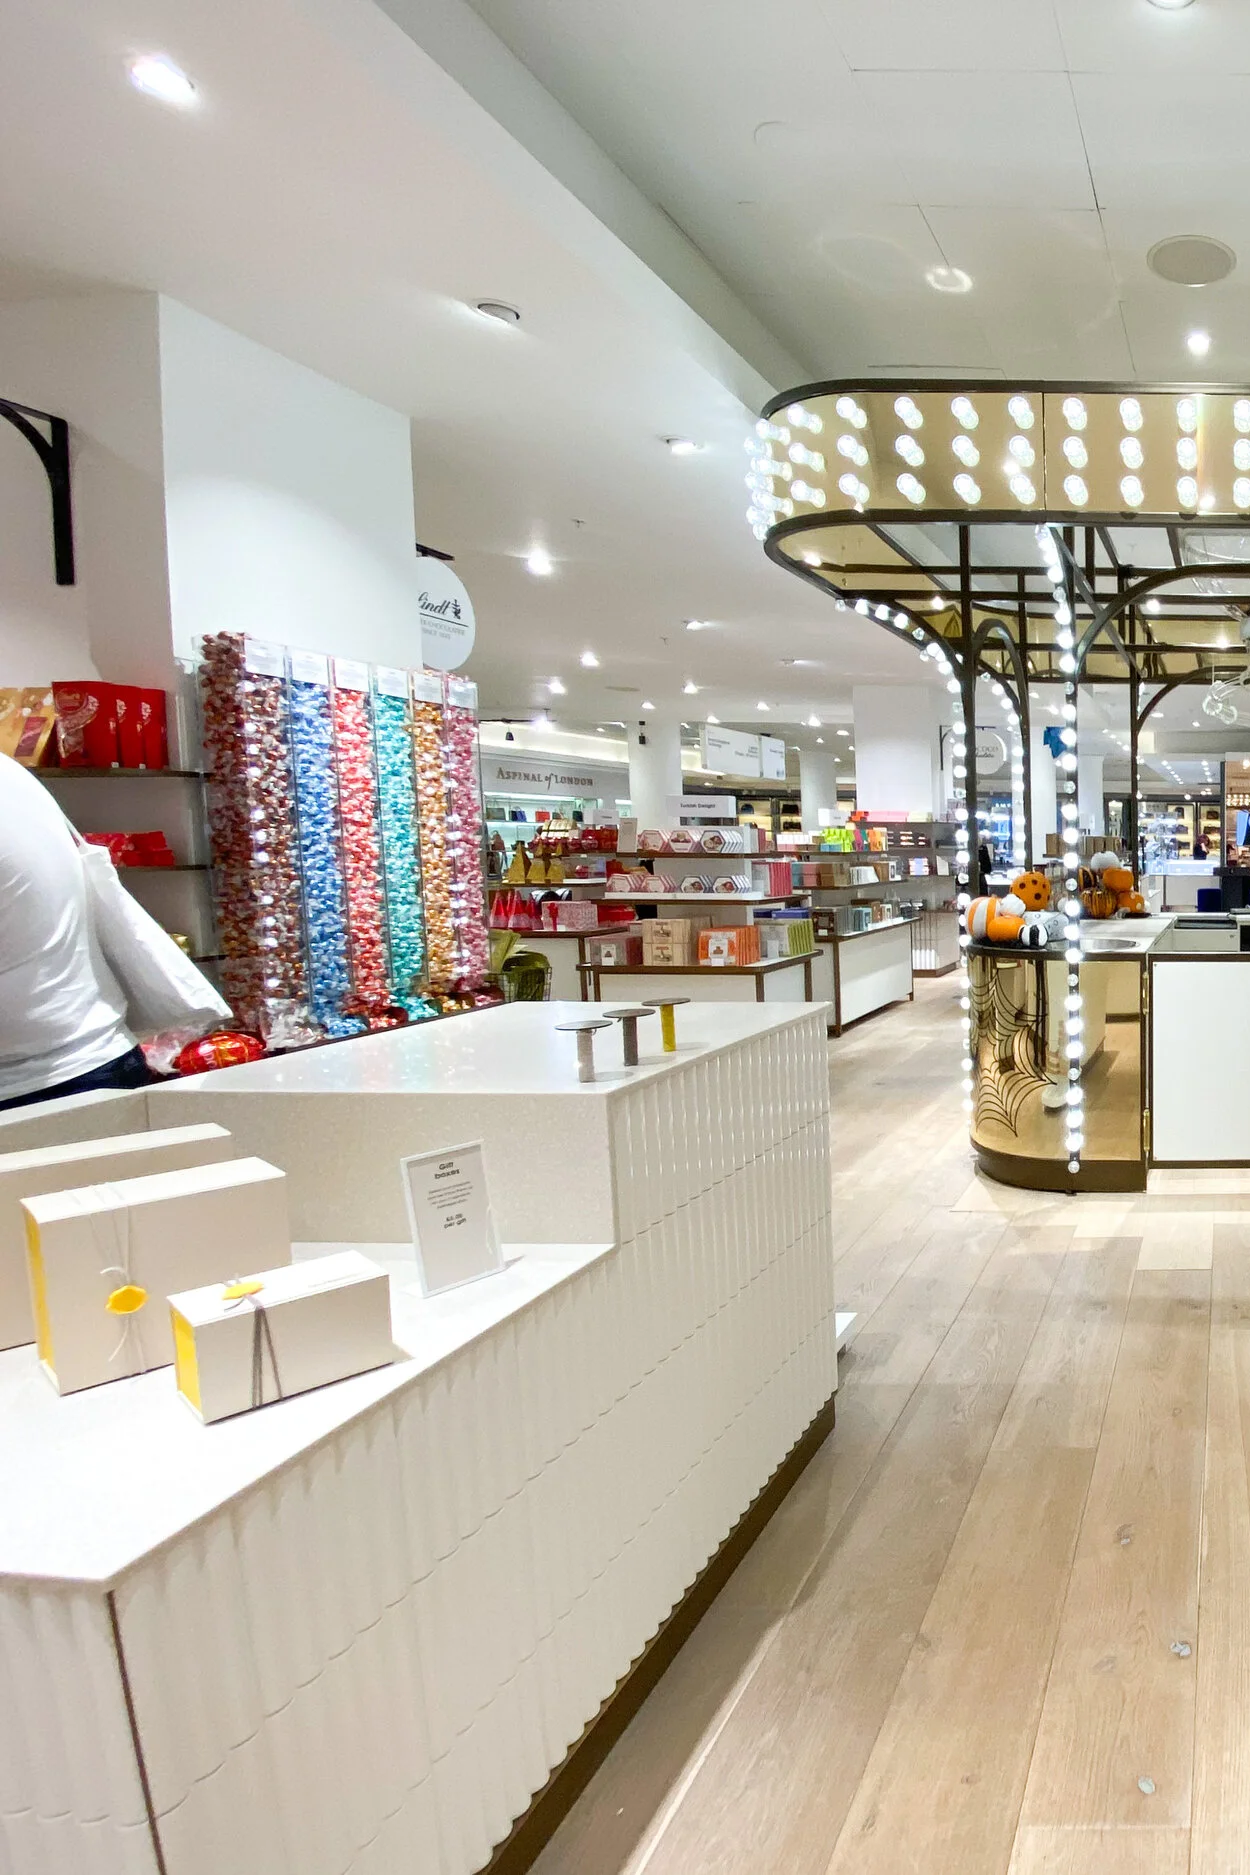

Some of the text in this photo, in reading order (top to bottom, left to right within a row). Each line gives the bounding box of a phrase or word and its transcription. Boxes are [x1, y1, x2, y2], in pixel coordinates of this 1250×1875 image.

[496, 767, 543, 783] ASPINAL
[555, 775, 593, 786] LONDON
[438, 1161, 454, 1170] Gift
[434, 1169, 460, 1179] boxes
